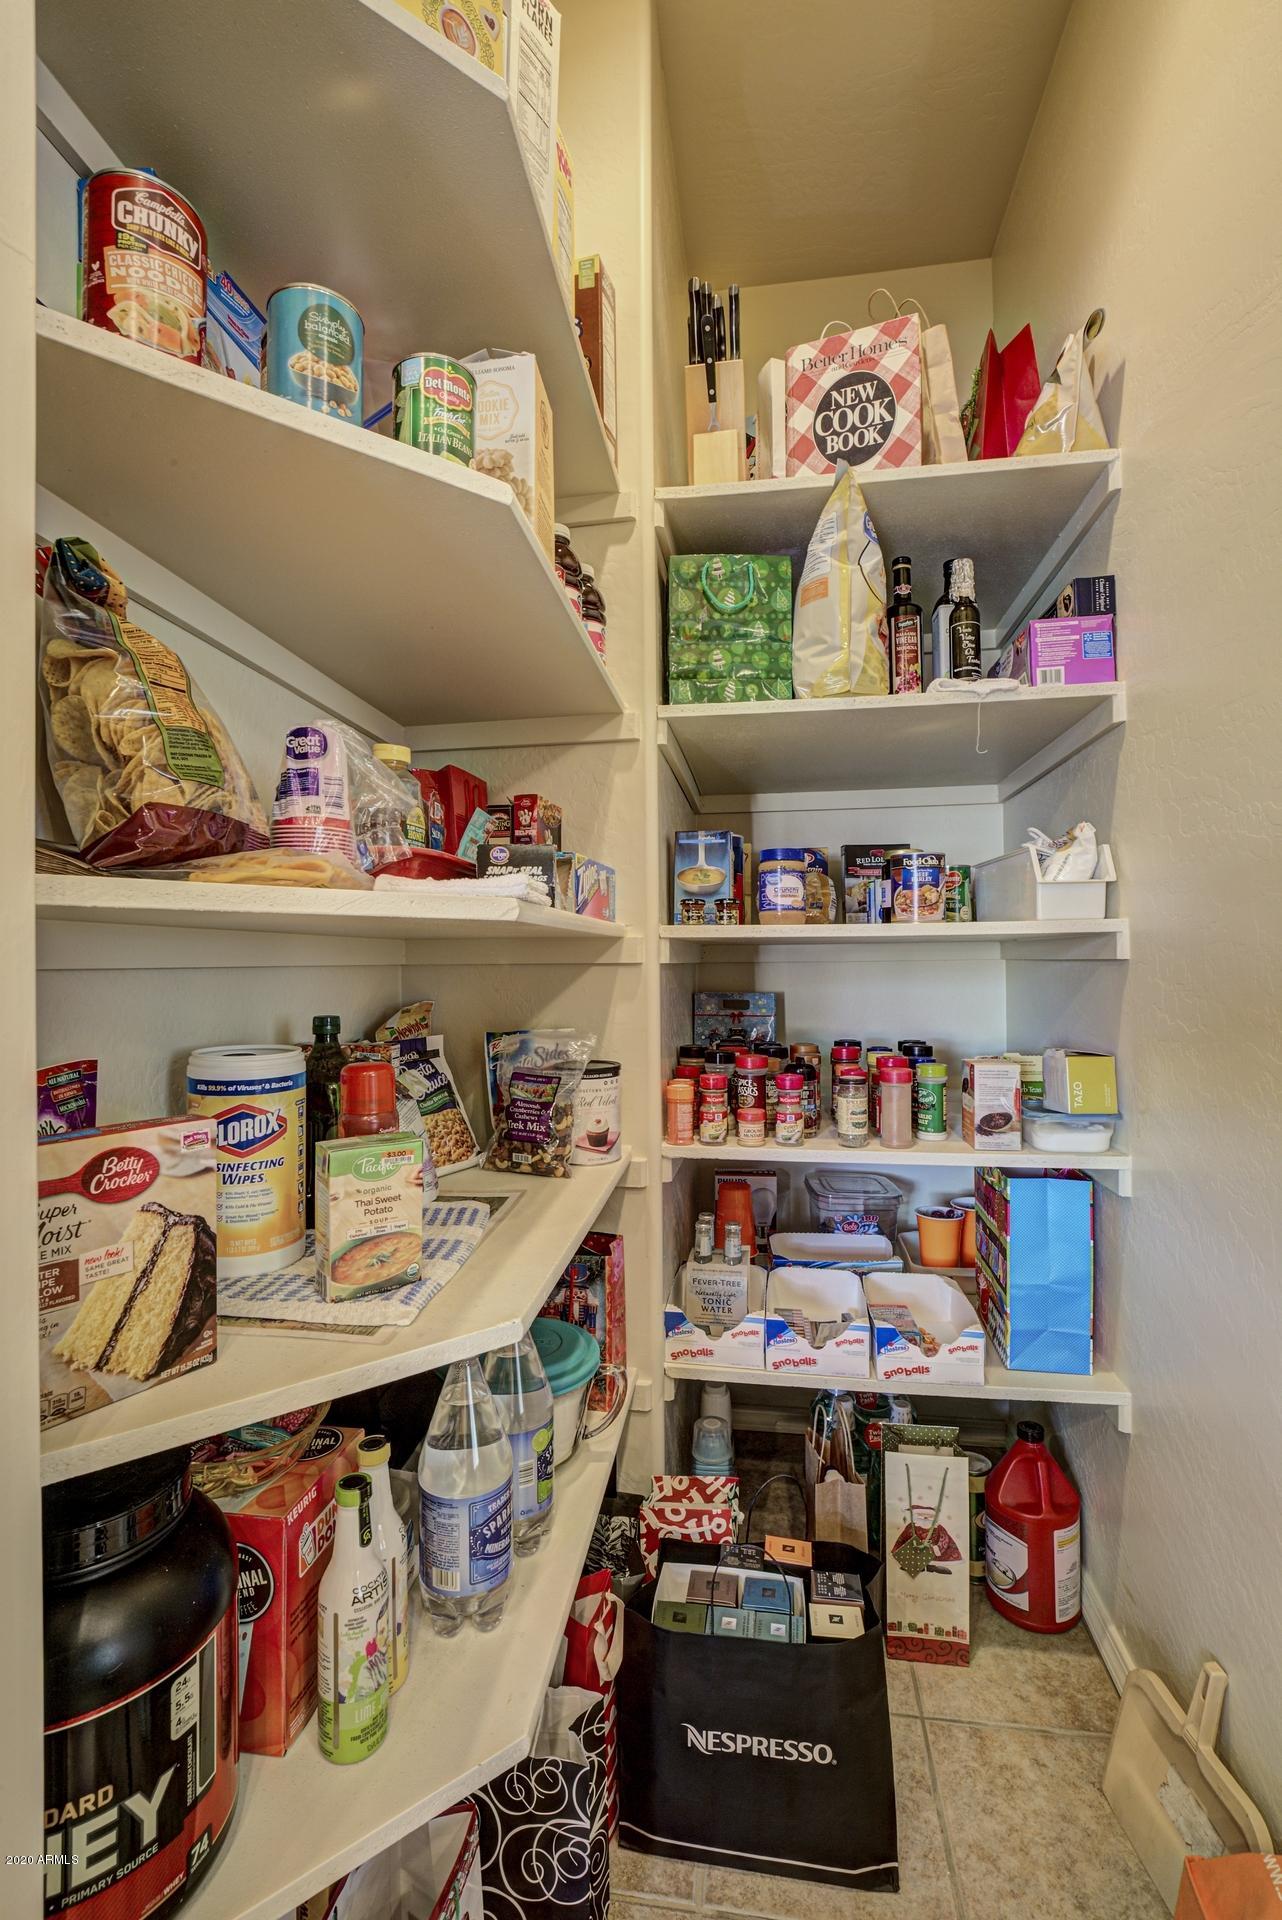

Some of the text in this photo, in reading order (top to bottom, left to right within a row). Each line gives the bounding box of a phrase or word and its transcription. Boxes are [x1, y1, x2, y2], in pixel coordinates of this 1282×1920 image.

[522, 3, 553, 47] FLAKES
[134, 190, 188, 230] Campbell's
[117, 200, 199, 259] CHUNKY
[109, 253, 164, 272] CLASSIC
[308, 311, 348, 336] Simply
[802, 350, 849, 372] Better
[425, 376, 442, 389] Del
[443, 379, 471, 402] Monte
[830, 380, 878, 410] NEW
[476, 398, 509, 413] OOKIE
[479, 414, 501, 426] MIX
[815, 397, 894, 437] COOK
[417, 432, 452, 446] ITALIAN
[825, 424, 885, 455] BOOK
[896, 636, 917, 644] VINEGAR
[286, 735, 321, 748] Great
[294, 745, 321, 754] Value
[903, 855, 939, 868] Food Club
[486, 866, 513, 875] SNAP
[534, 1043, 570, 1069] Sides
[57, 1072, 80, 1082] NATURAL
[208, 1084, 226, 1092] 99.9%
[271, 1080, 294, 1089] Bacteria
[1028, 1085, 1042, 1093] Teas
[1073, 1081, 1083, 1108] TAZO
[509, 1106, 540, 1115] Cranberries
[514, 1113, 538, 1121] Cashews
[216, 1107, 281, 1148] LOROX
[508, 1120, 546, 1132] Trek Mix
[386, 1150, 407, 1158] $3.00
[102, 1156, 143, 1177] Betty
[216, 1156, 285, 1173] SINFECTING
[356, 1157, 397, 1176] Pacific
[90, 1170, 152, 1195] Crocker
[222, 1173, 265, 1186] WIPES
[363, 1184, 392, 1195] organic
[354, 1193, 402, 1209] Thai Sweet
[38, 1202, 78, 1220] uper
[363, 1206, 394, 1217] Potato
[369, 1217, 389, 1225] SOUP
[38, 1220, 83, 1247] oist
[51, 1245, 72, 1256] MIX
[84, 1254, 102, 1266] new
[85, 1255, 130, 1273] SAME GREAT
[39, 1268, 60, 1280] TER
[85, 1269, 110, 1280] TASTE!
[692, 1277, 742, 1288] FEVER-TREE
[39, 1285, 64, 1298] LOW
[702, 1297, 732, 1306] TONIC
[701, 1305, 733, 1314] WATER
[671, 1348, 714, 1361] Snoballs
[772, 1356, 817, 1370] Snoballs
[883, 1365, 931, 1380] Snoballs
[286, 1486, 318, 1526] KEURIG
[238, 1587, 255, 1599] END
[680, 1722, 834, 1765] NESPRESSO
[44, 1784, 114, 1830] DARD
[191, 1832, 209, 1866] 74
[61, 1843, 160, 1909] PRIMARY SOURCE
